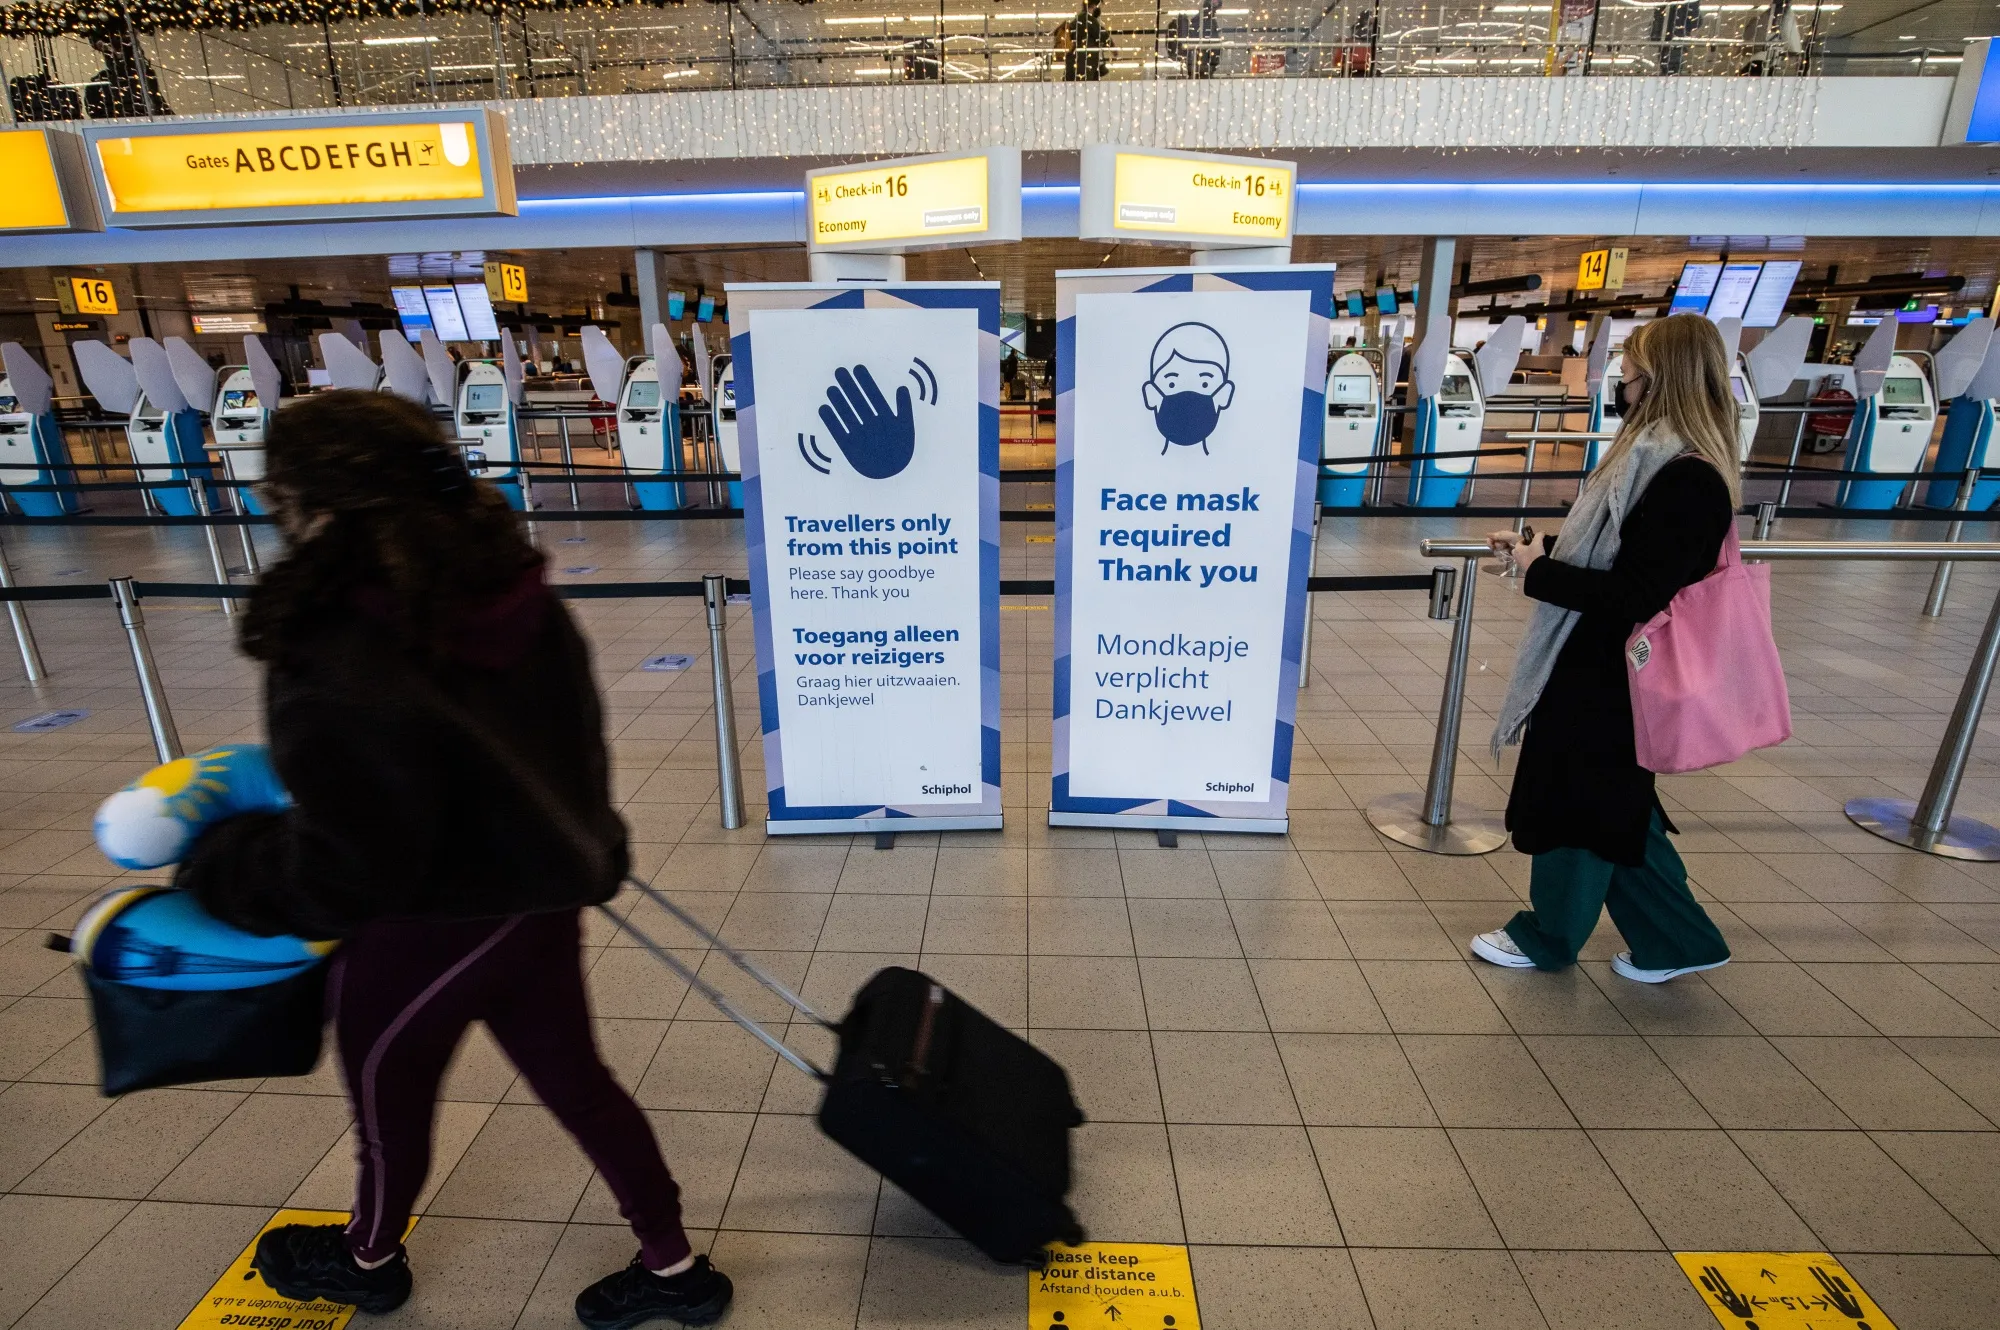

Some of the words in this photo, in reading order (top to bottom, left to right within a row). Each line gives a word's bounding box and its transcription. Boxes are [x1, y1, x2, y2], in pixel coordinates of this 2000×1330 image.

[186, 154, 230, 170] Gates
[835, 182, 882, 199] Check-in
[885, 175, 908, 198] 16
[1193, 173, 1241, 189] Check-in
[1245, 175, 1265, 197] 16
[963, 210, 979, 220] only
[1159, 210, 1174, 221] only
[1233, 212, 1281, 229] Economy
[818, 219, 867, 233] Economy
[487, 265, 496, 273] 15
[1586, 254, 1602, 278] 14
[506, 268, 522, 291] 15
[81, 281, 108, 304] 16
[1100, 488, 1167, 511] Face
[1176, 487, 1260, 511] mask
[785, 514, 895, 533] Travellers
[901, 513, 951, 535] only
[1099, 523, 1231, 552] required
[787, 538, 843, 556] from
[849, 538, 892, 555] this
[898, 536, 958, 559] point
[788, 567, 836, 581] Please
[840, 569, 864, 583] say
[868, 565, 935, 583] goodbye
[1098, 558, 1191, 582] Thank
[1200, 564, 1258, 588] you
[790, 587, 828, 600] here.
[831, 585, 879, 599] Thank
[882, 587, 910, 601] you
[793, 627, 888, 648] Toegang
[893, 625, 960, 643] alleen
[1097, 634, 1249, 662] Mondkapje
[795, 653, 845, 666] voor
[851, 648, 945, 668] reizigers
[796, 676, 841, 690] Graag
[844, 675, 872, 688] hier
[876, 673, 961, 687] uitzwaaien.
[1095, 666, 1210, 693] verplicht
[798, 692, 875, 709] Dankjewel
[1096, 699, 1232, 726] Dankjewel
[921, 783, 972, 796] Schiphol
[1205, 781, 1255, 794] Schiphol
[1049, 1251, 1092, 1264] lease
[1098, 1251, 1139, 1268] keep
[1040, 1268, 1079, 1281] your
[1084, 1266, 1156, 1282] distance
[1040, 1283, 1090, 1294] Afstand
[1095, 1285, 1144, 1297] houden
[1149, 1287, 1185, 1298] a.u.b.
[212, 1296, 245, 1308] a.u.b.
[247, 1299, 296, 1312] houden
[296, 1302, 347, 1315] Afstand
